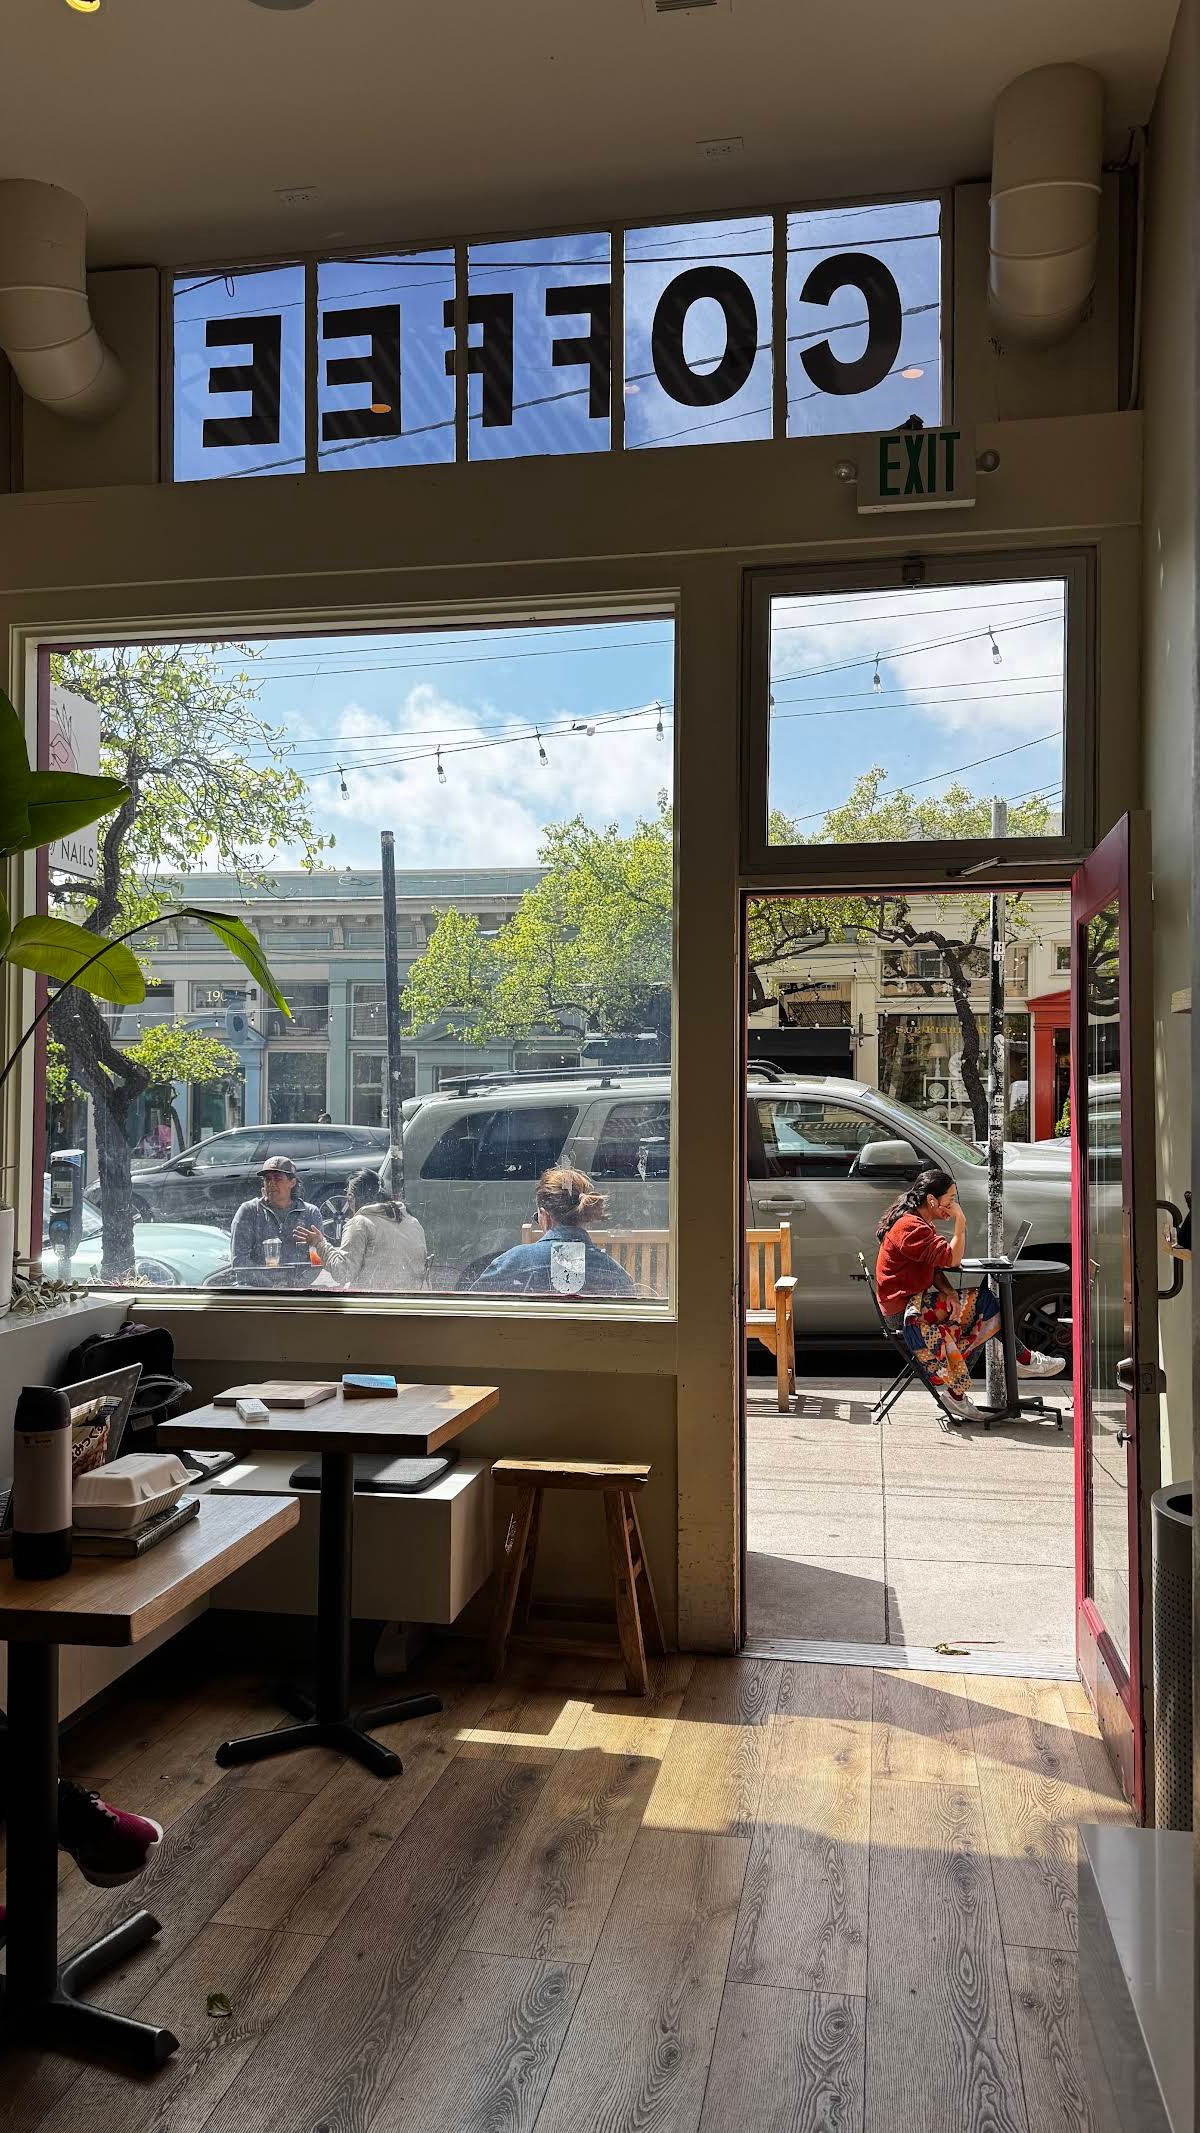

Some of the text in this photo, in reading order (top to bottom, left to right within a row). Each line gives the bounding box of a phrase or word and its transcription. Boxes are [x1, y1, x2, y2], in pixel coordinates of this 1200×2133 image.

[880, 432, 960, 496] EXIT
[61, 839, 94, 868] NAILS
[926, 1025, 961, 1034] FISH
